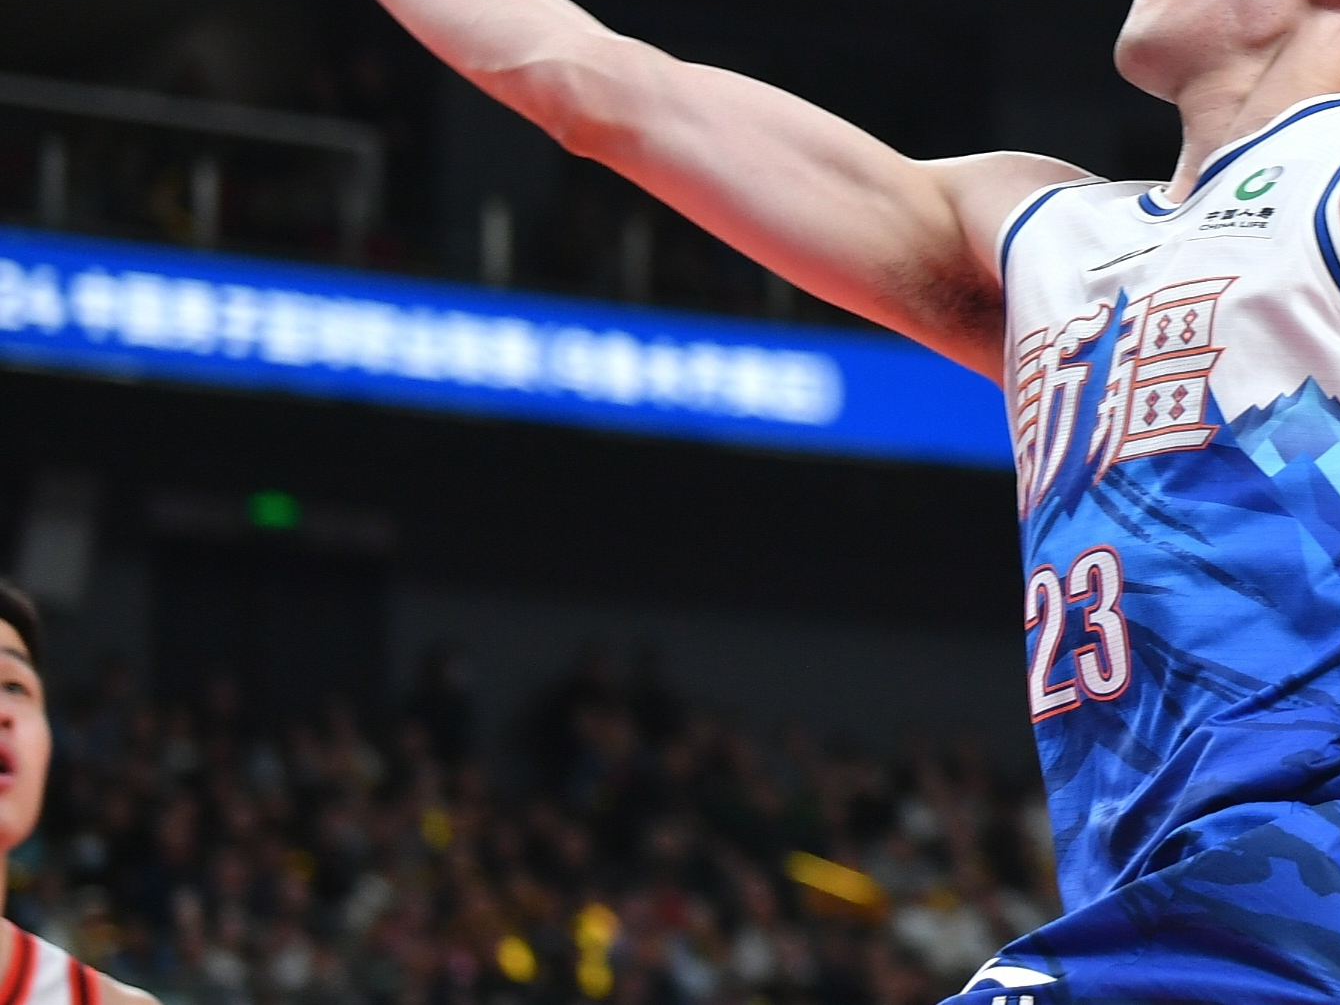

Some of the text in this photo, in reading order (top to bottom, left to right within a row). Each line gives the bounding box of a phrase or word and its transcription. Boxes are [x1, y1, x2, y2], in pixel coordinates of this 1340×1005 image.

[1203, 206, 1276, 222] 中国人寿
[1198, 220, 1270, 231] CHINA LIFE
[1024, 544, 1132, 724] 23
